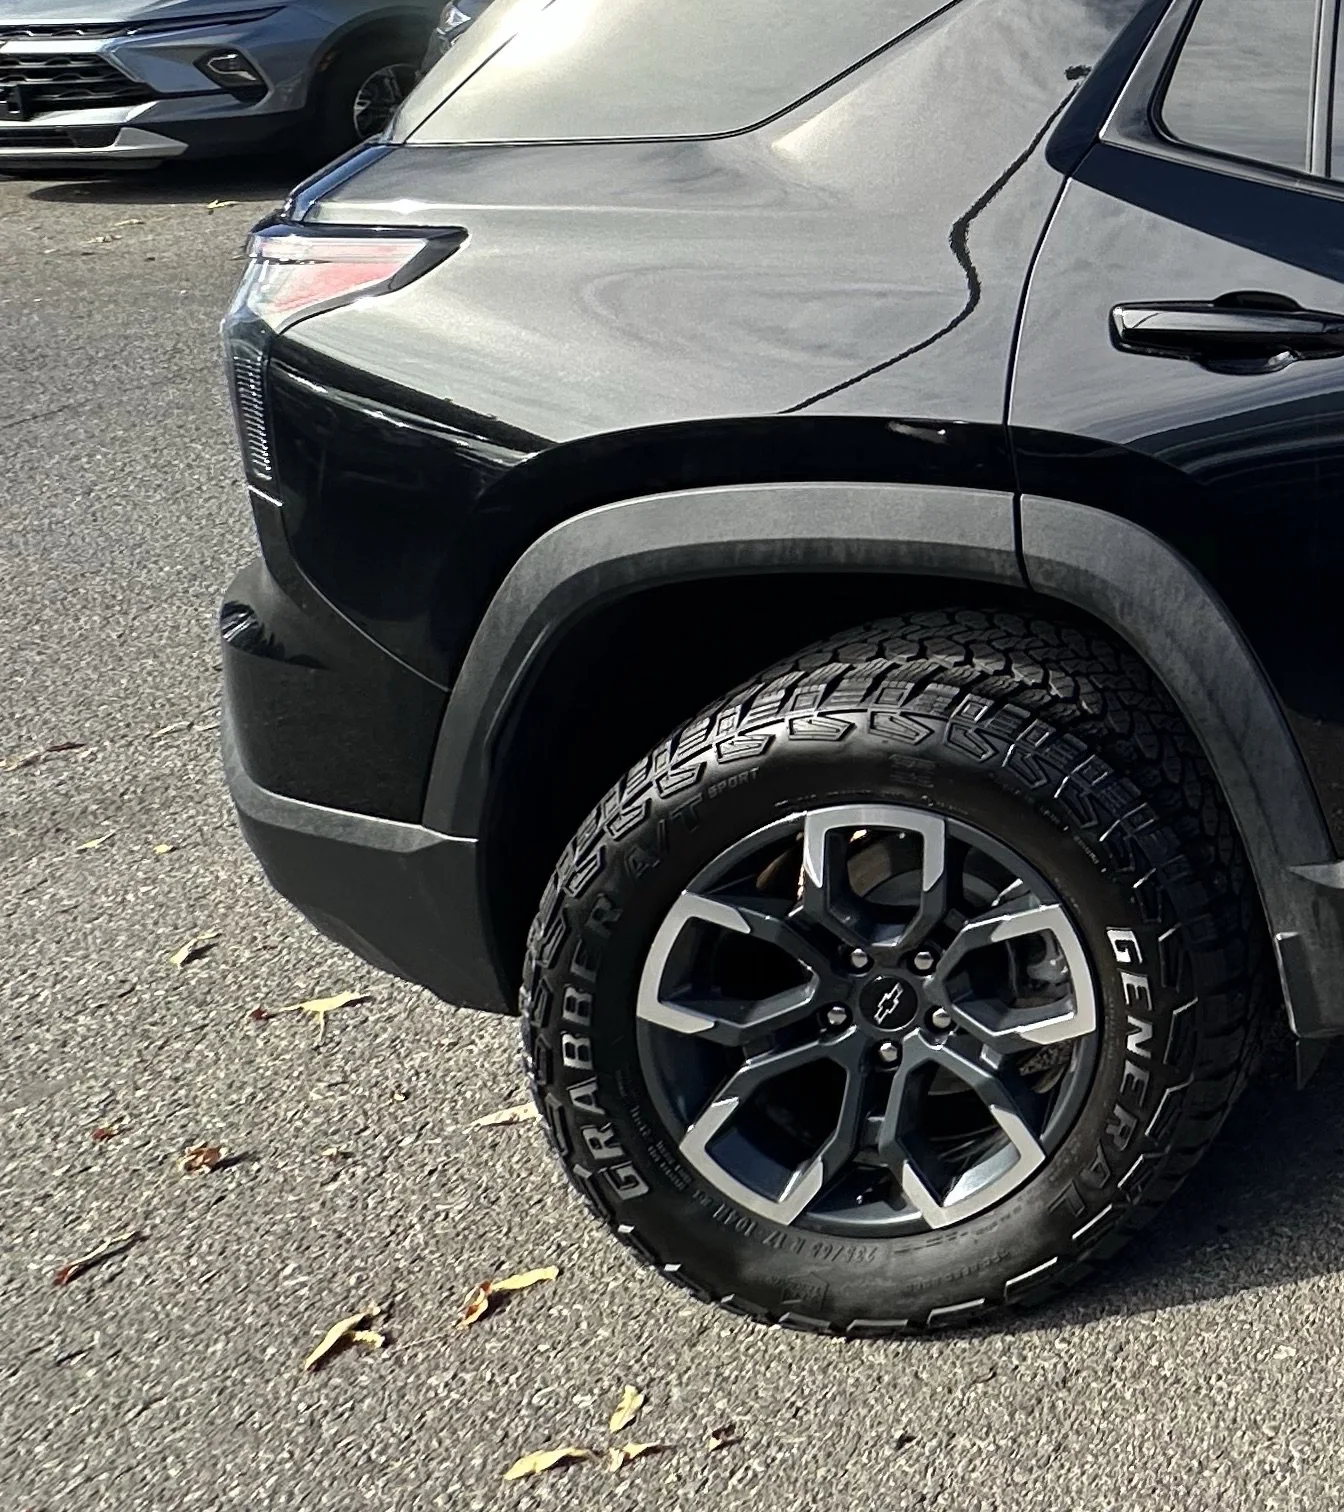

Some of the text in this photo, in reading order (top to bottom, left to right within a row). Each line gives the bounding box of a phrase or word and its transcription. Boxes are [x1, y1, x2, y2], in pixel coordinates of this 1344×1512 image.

[625, 767, 758, 880] A/T SPORT
[559, 891, 649, 1199] GRABBER
[1049, 926, 1153, 1217] GENERAL
